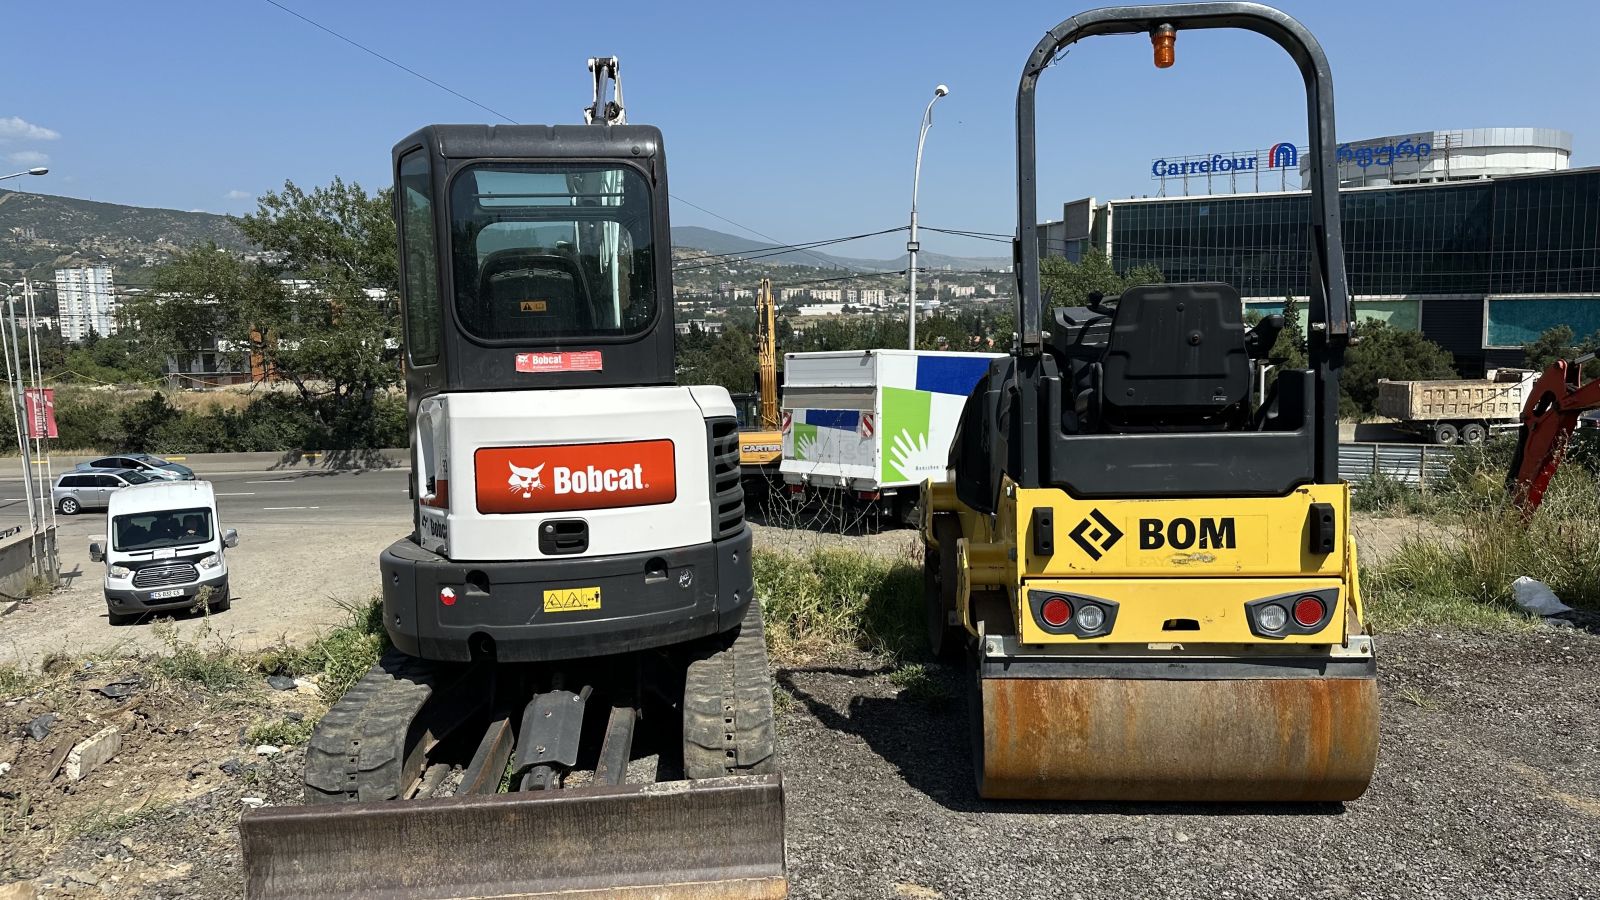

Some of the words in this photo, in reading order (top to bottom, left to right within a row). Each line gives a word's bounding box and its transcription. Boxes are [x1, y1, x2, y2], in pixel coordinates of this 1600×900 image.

[1336, 138, 1432, 168] რფური
[1152, 155, 1257, 177] Carrefour
[532, 355, 562, 365] Bobcat
[742, 444, 781, 452] CARTER
[554, 463, 643, 495] Bobcat
[430, 518, 447, 539] Bobc
[1139, 517, 1236, 549] BOM
